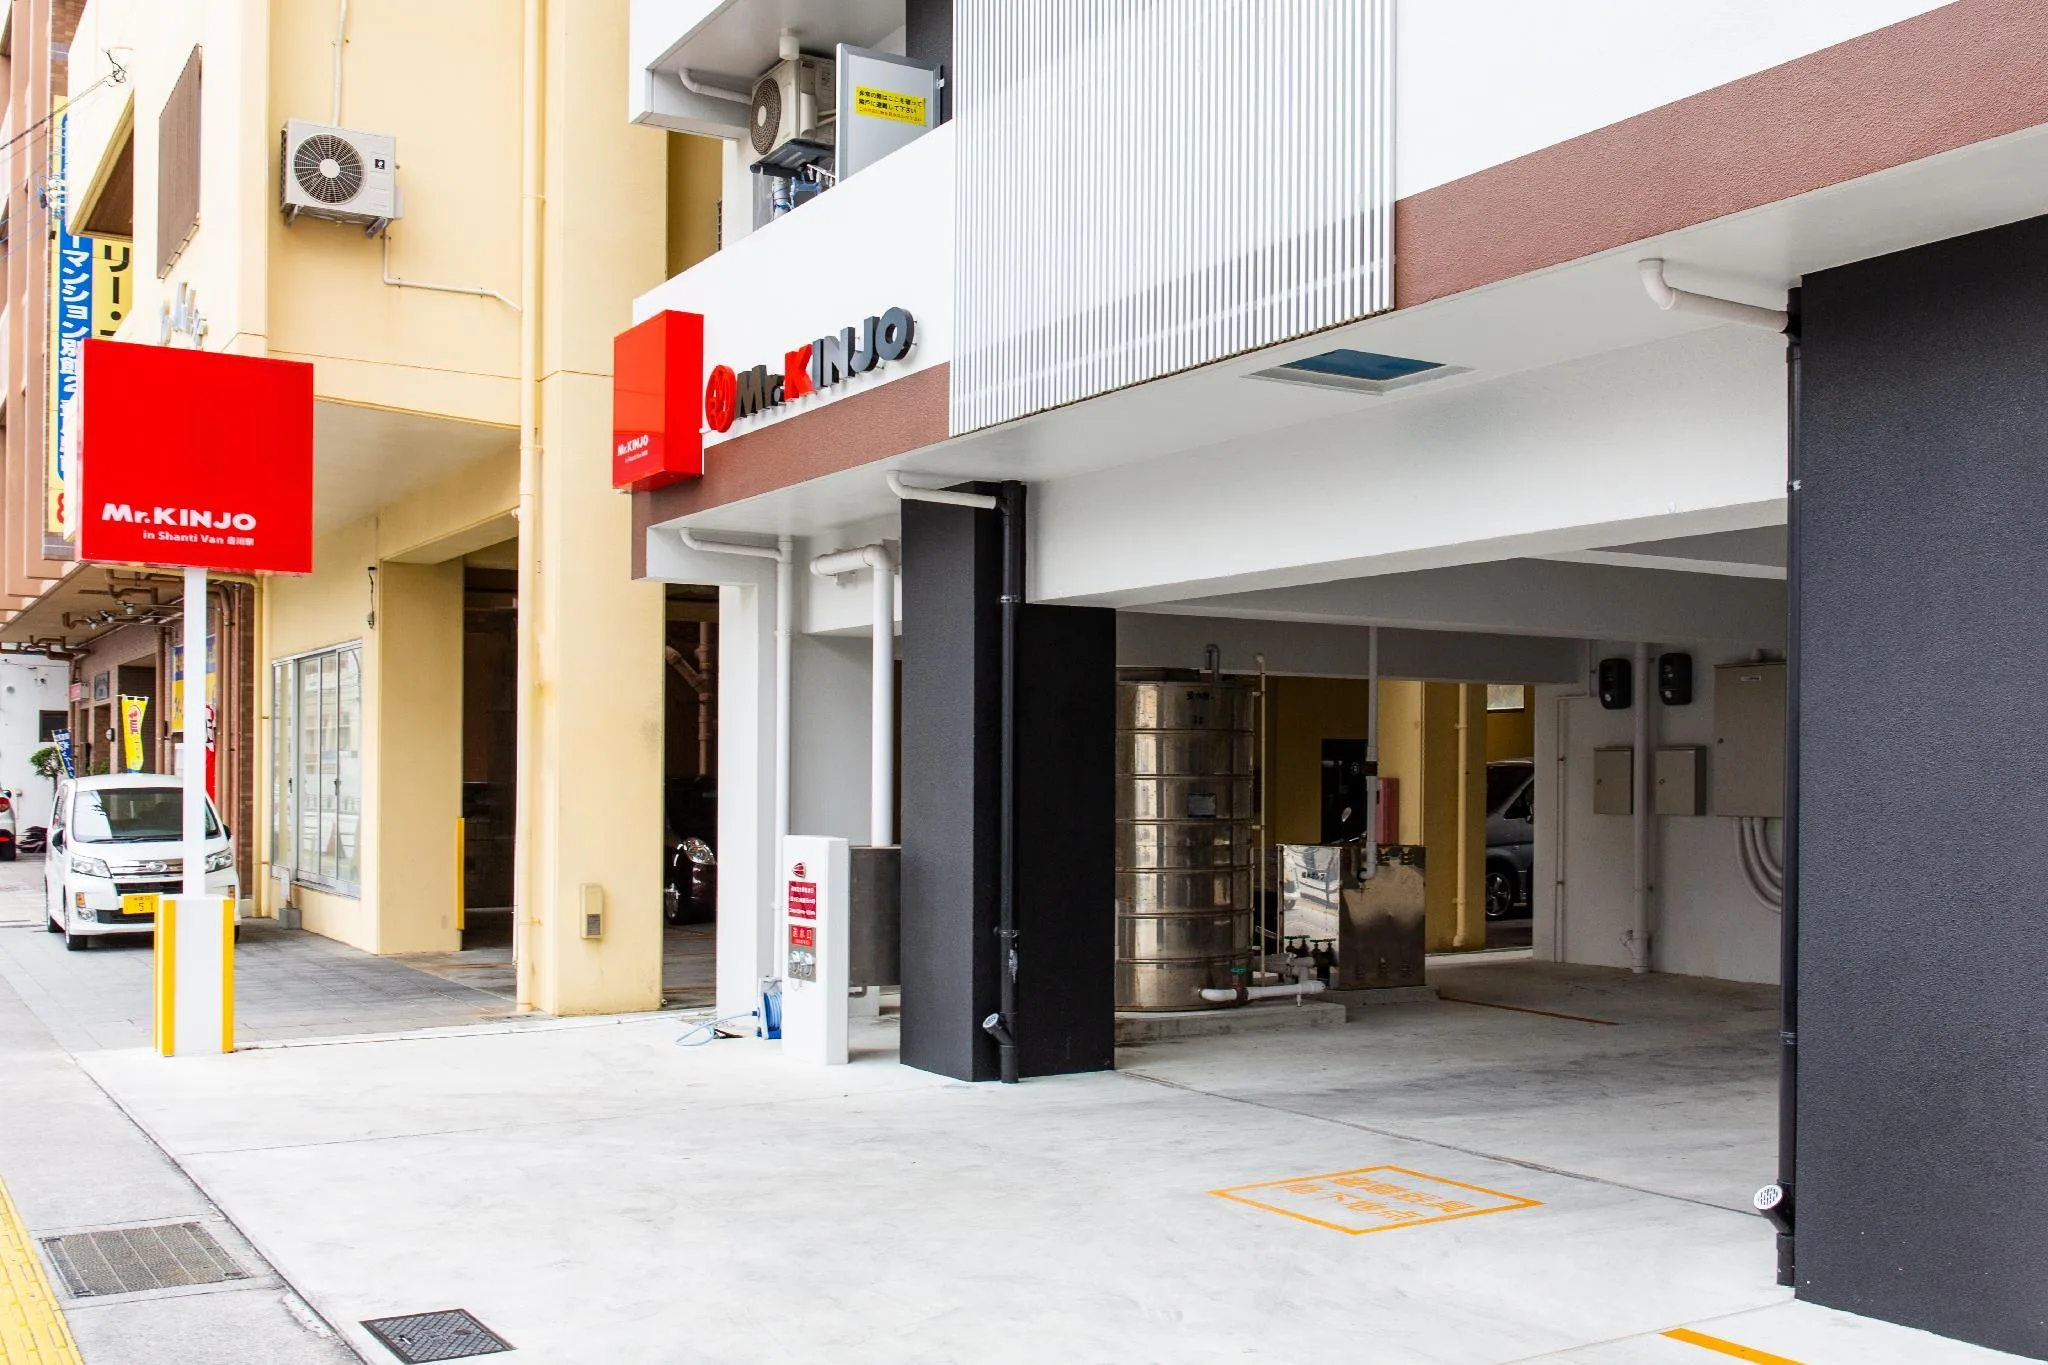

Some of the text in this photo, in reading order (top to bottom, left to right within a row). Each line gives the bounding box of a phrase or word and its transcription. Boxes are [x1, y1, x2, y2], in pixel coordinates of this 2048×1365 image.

[735, 307, 915, 419] Mr.KINJO
[102, 503, 257, 531] Mr.KINJO
[143, 530, 155, 540] in
[158, 531, 198, 543] Shanti
[200, 534, 224, 544] Van
